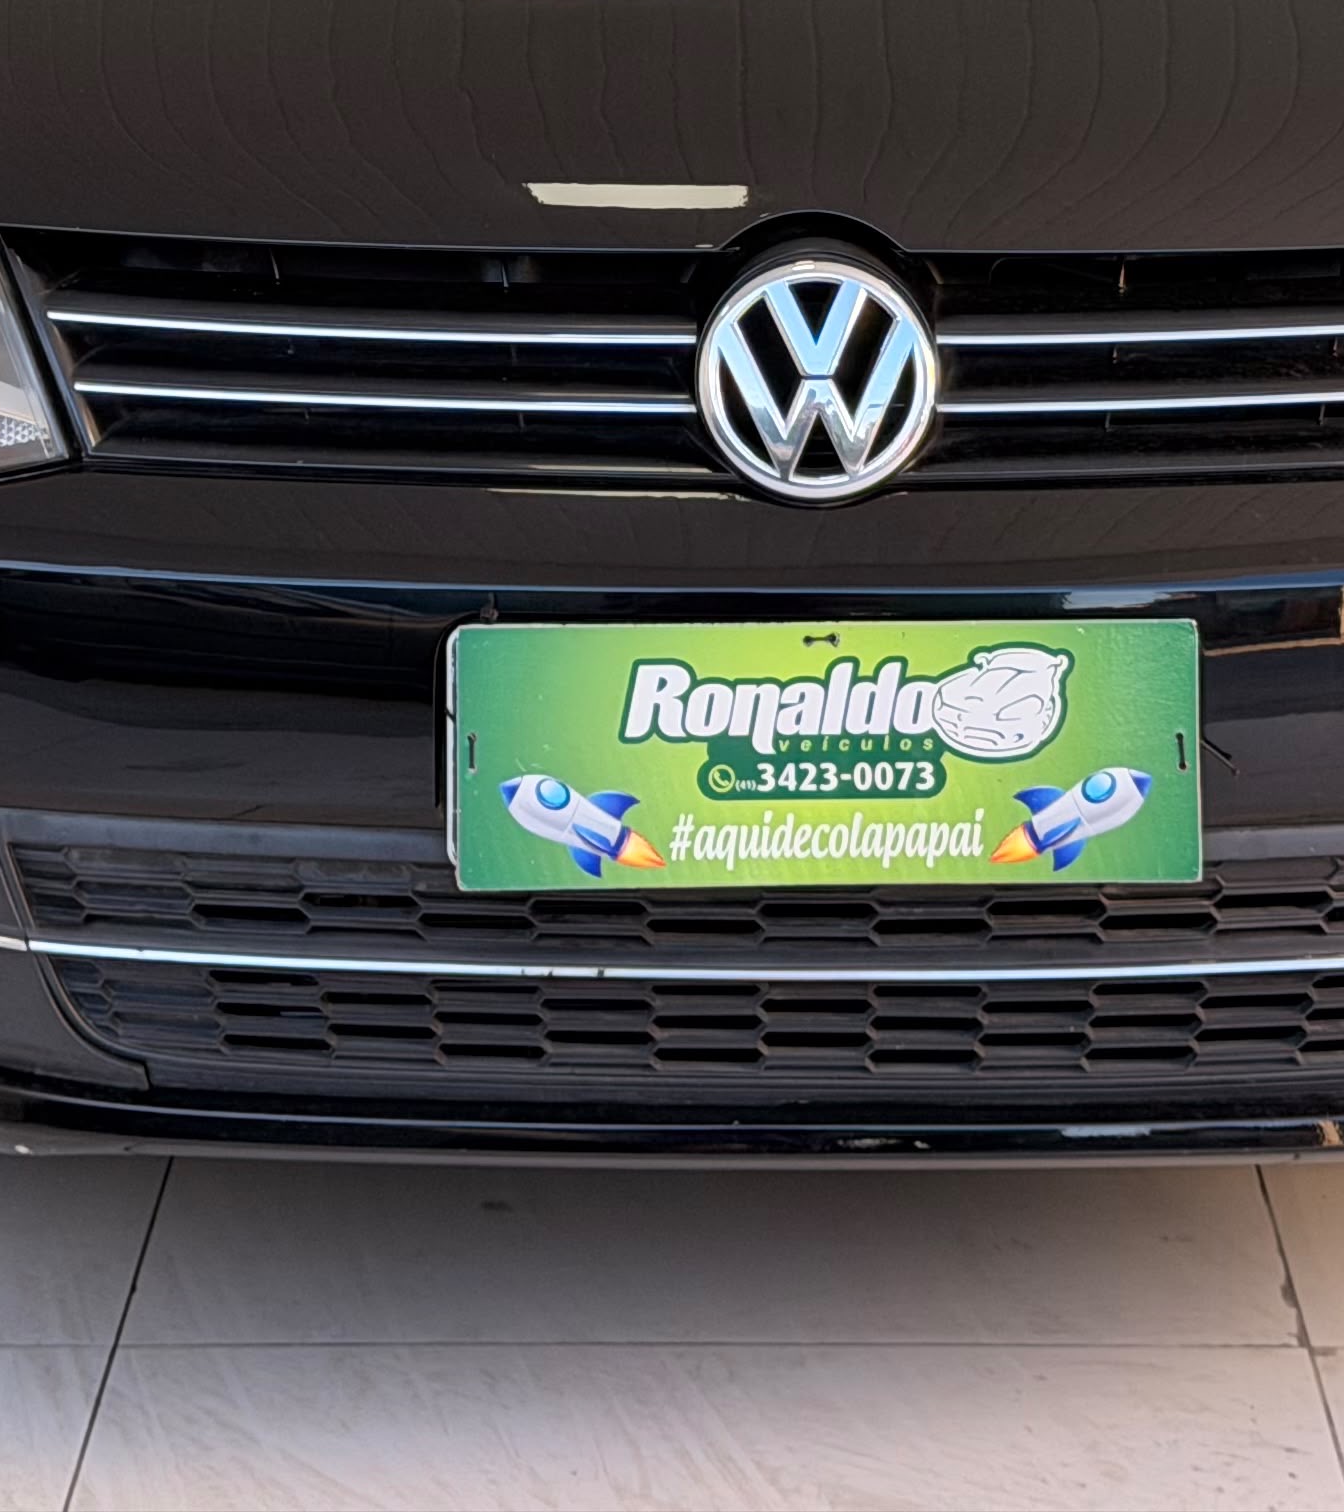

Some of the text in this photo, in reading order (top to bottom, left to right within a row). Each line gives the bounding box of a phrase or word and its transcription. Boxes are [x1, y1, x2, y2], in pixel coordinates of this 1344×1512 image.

[697, 260, 936, 500] VW
[624, 661, 937, 755] Ronaldo
[756, 761, 935, 792] 3423-0073
[669, 808, 985, 871] #aquidecolapapai
